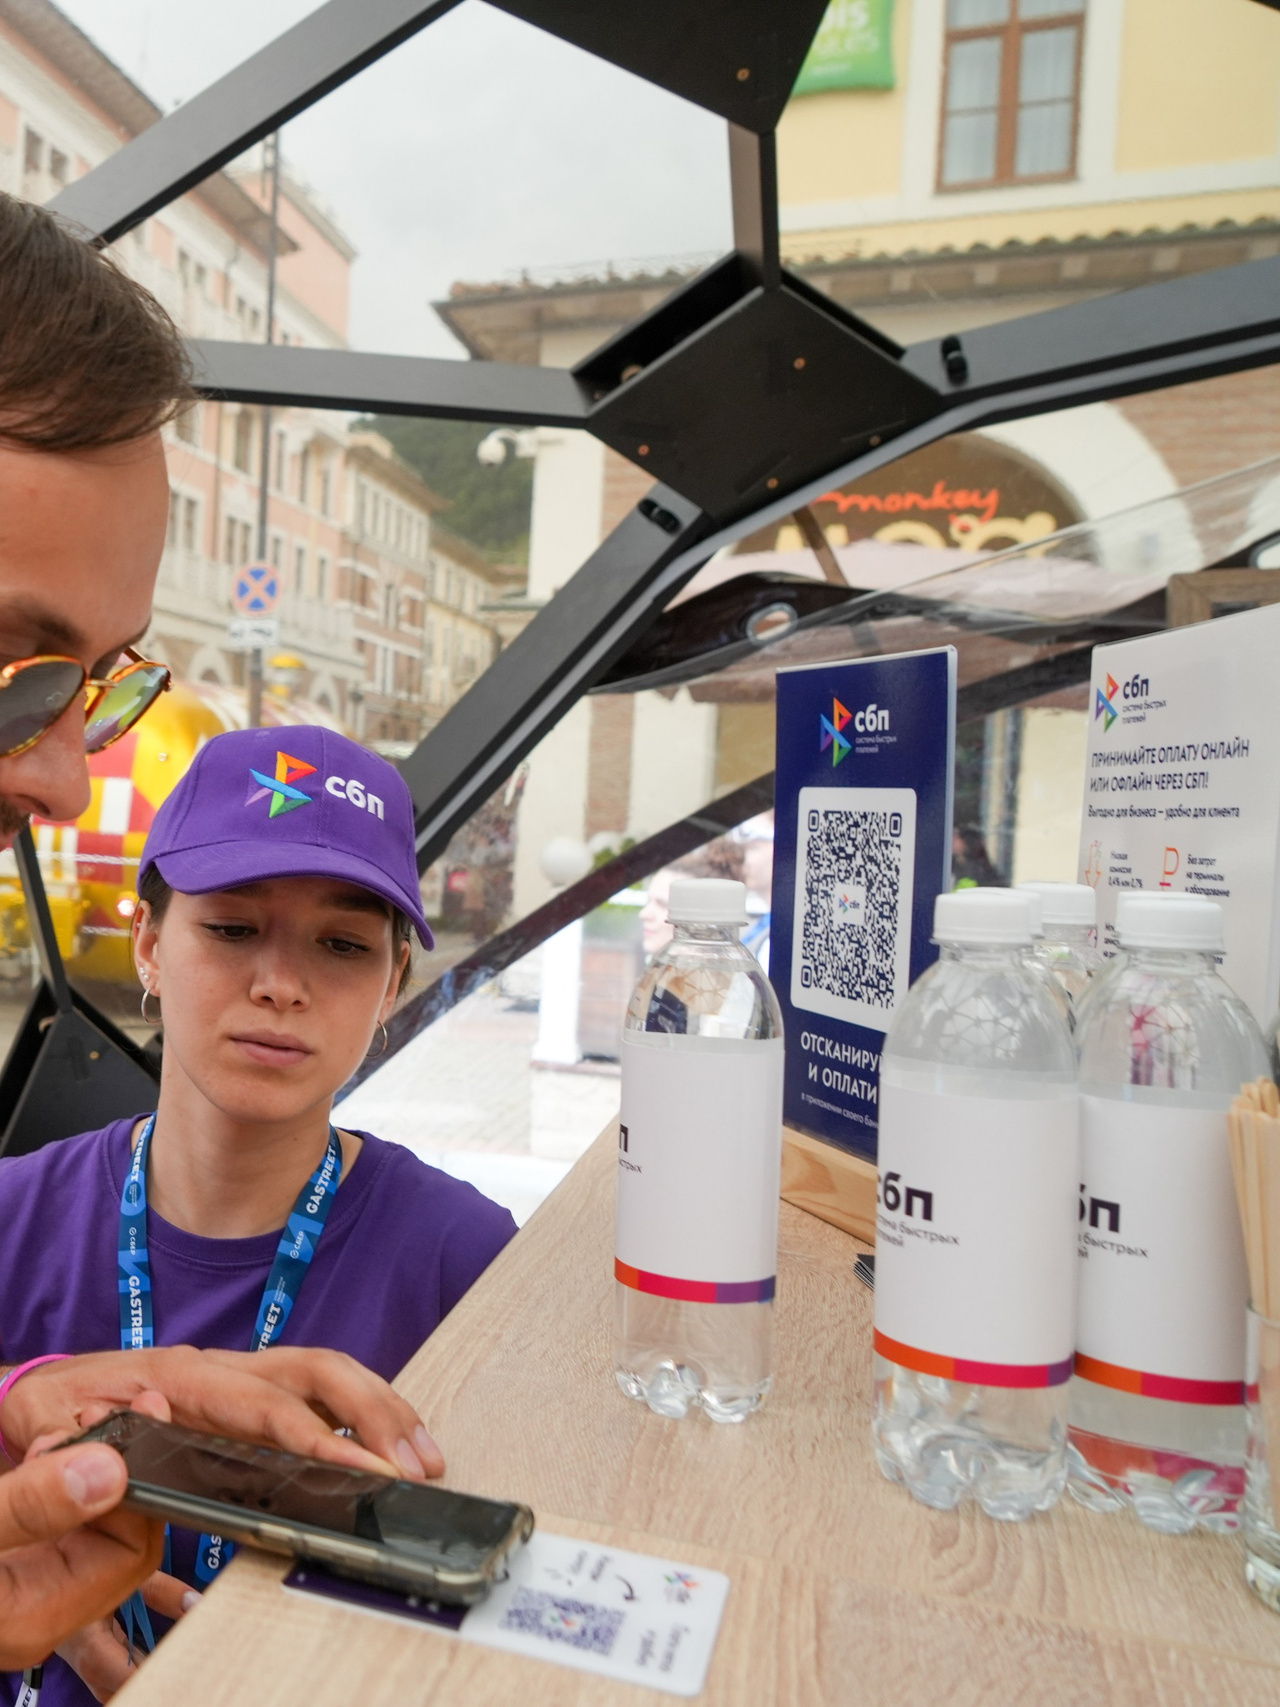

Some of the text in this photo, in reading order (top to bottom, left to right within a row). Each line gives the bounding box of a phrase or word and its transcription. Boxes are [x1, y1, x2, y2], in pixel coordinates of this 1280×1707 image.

[811, 481, 999, 523] monkey
[1123, 674, 1150, 699] сбп
[854, 703, 890, 732] сбп
[1091, 736, 1250, 768] ПРИНИМАЙТЕ ОПЛАТУ ОНЛАЙН
[1090, 771, 1209, 792] ИЛИ ОФЛАЙН ЧЕРЕЗ СБП!
[324, 775, 385, 822] сбп
[1088, 805, 1114, 818] Выгодно
[1115, 807, 1128, 818] для
[1129, 805, 1156, 818] бизнеса
[1164, 804, 1191, 820] удобно
[1193, 807, 1206, 819] для
[1208, 806, 1240, 818] клиента
[808, 1062, 877, 1104] И ОПЛАТИ
[842, 1108, 864, 1124] своего
[306, 1145, 337, 1214] GASTREET
[293, 1230, 305, 1250] СБЕР
[900, 1223, 960, 1246] быстрых
[1083, 1233, 1149, 1258] быстрых
